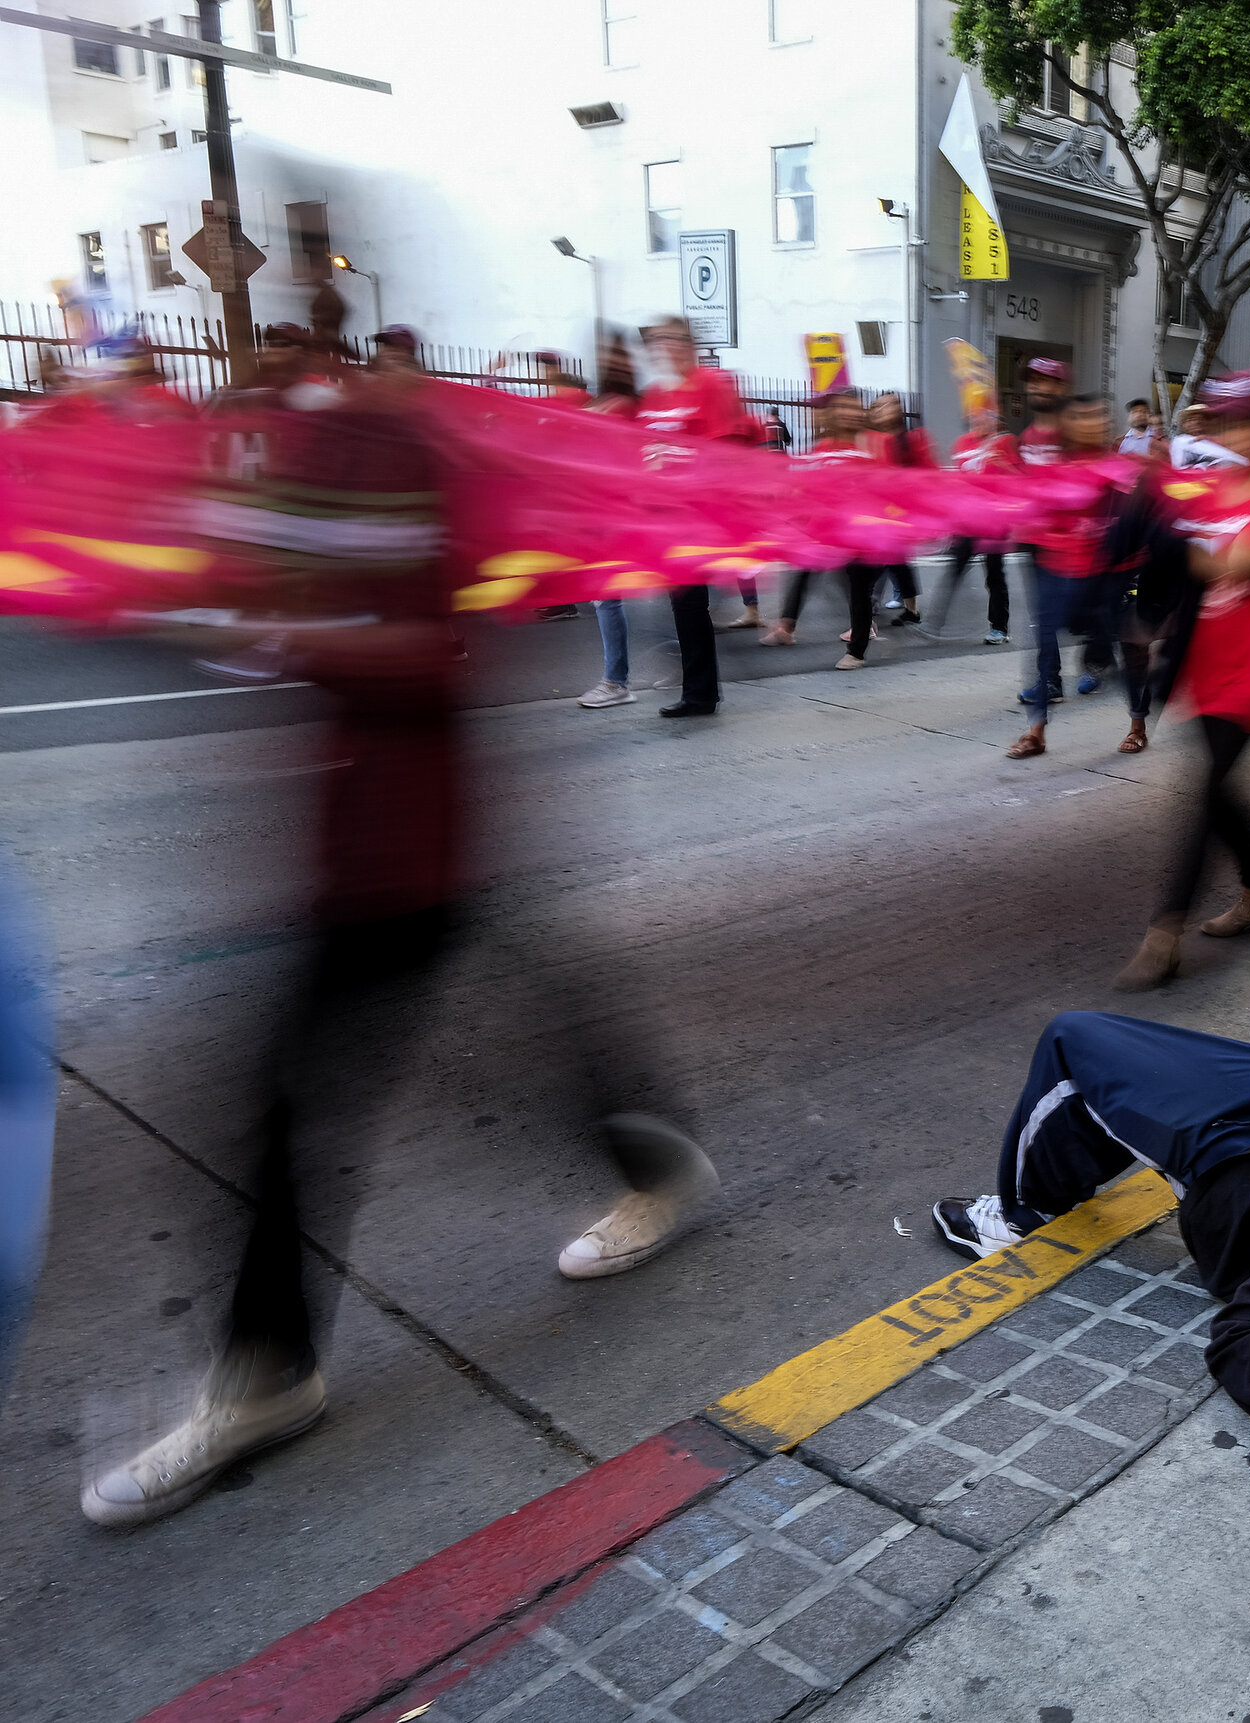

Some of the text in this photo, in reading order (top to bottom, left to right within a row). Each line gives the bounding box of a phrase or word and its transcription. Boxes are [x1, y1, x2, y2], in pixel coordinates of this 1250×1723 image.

[963, 208, 973, 275] LEASE
[697, 266, 711, 292] P
[1006, 294, 1040, 322] 548
[880, 1234, 1082, 1347] LADOT
